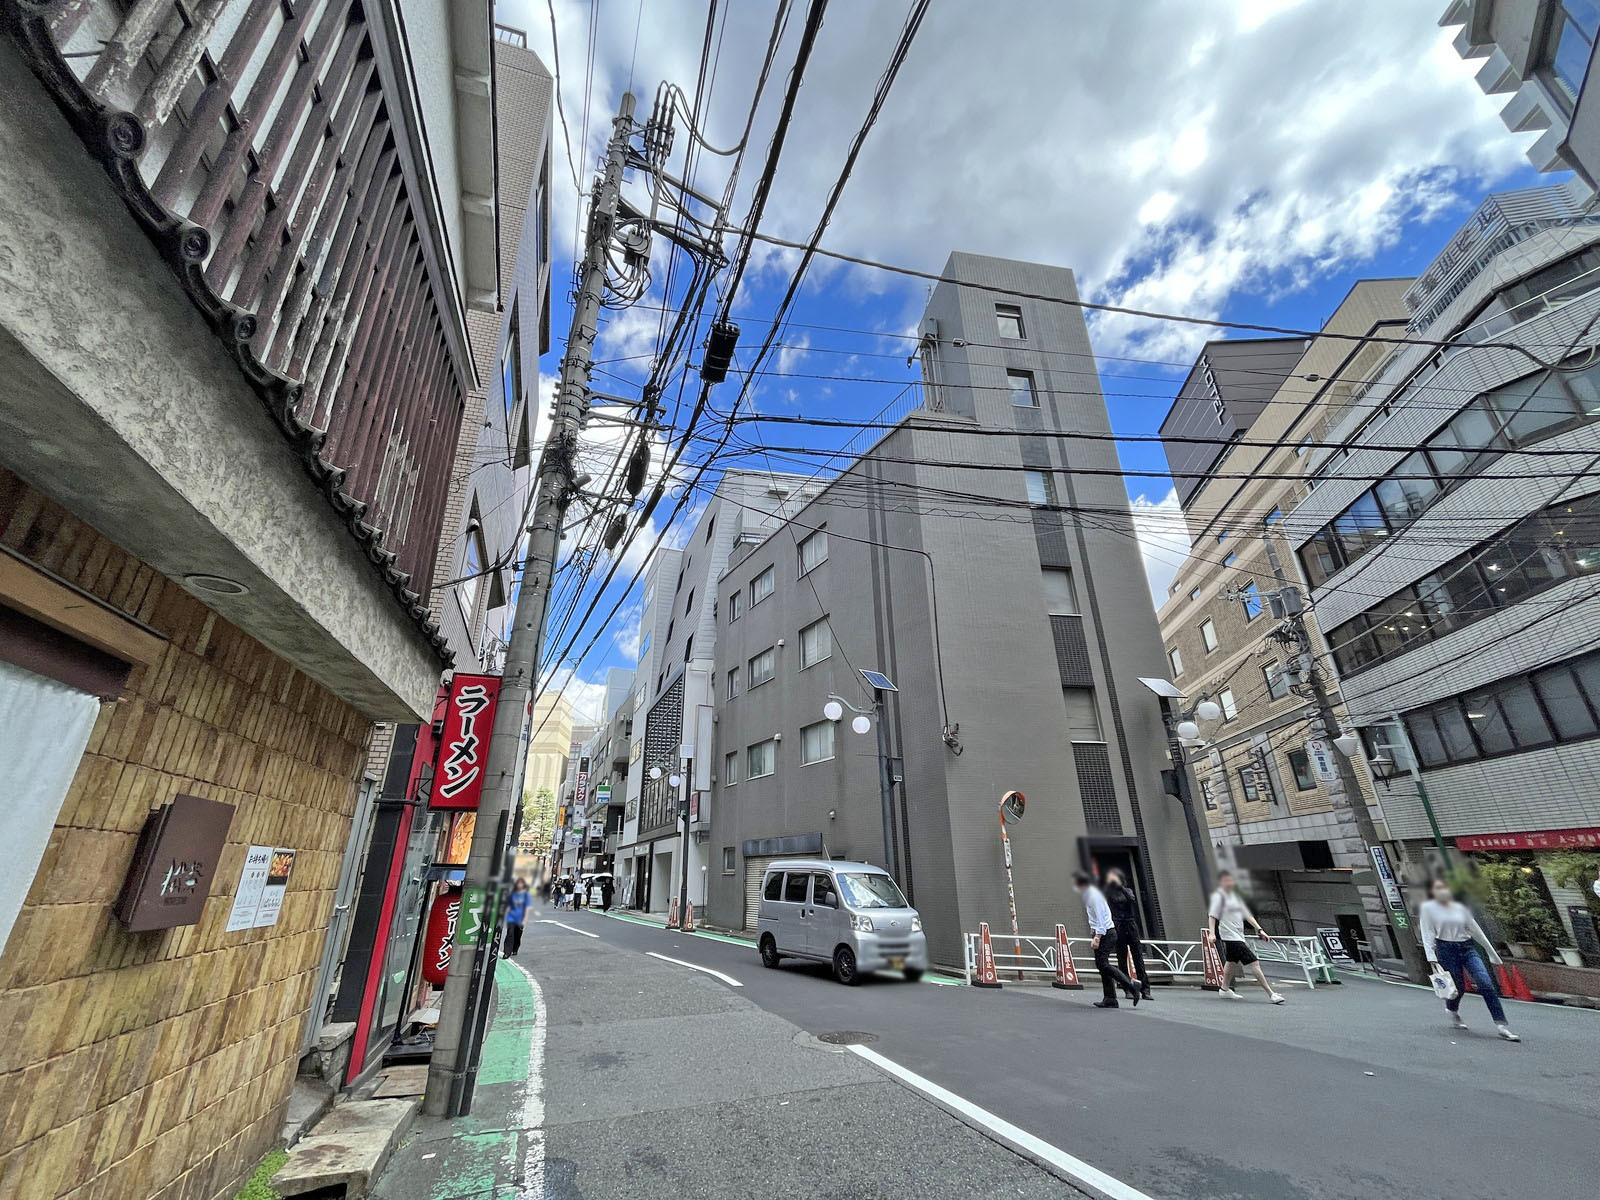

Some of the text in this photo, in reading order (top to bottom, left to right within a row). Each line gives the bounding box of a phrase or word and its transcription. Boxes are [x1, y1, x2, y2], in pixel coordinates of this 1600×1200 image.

[1200, 355, 1225, 426] HOTEL
[440, 684, 490, 799] ラーメン
